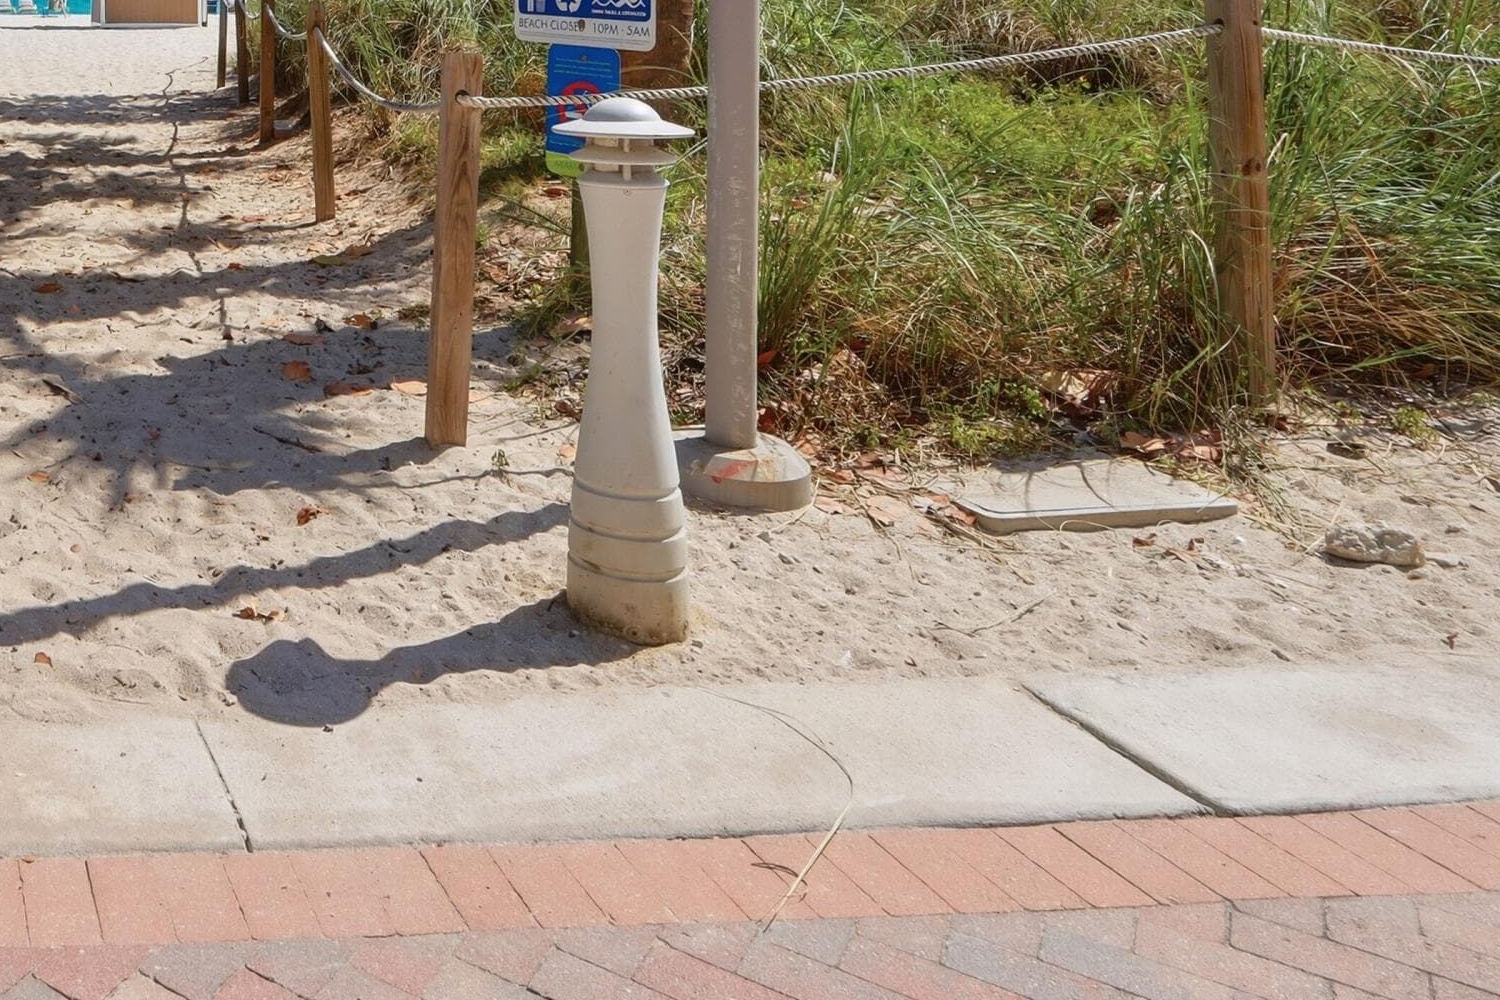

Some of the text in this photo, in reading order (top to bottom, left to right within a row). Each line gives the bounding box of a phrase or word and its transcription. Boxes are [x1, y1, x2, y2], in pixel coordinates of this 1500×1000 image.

[519, 18, 548, 29] BEACH
[593, 22, 619, 35] 10PM
[626, 25, 650, 37] 5AM
